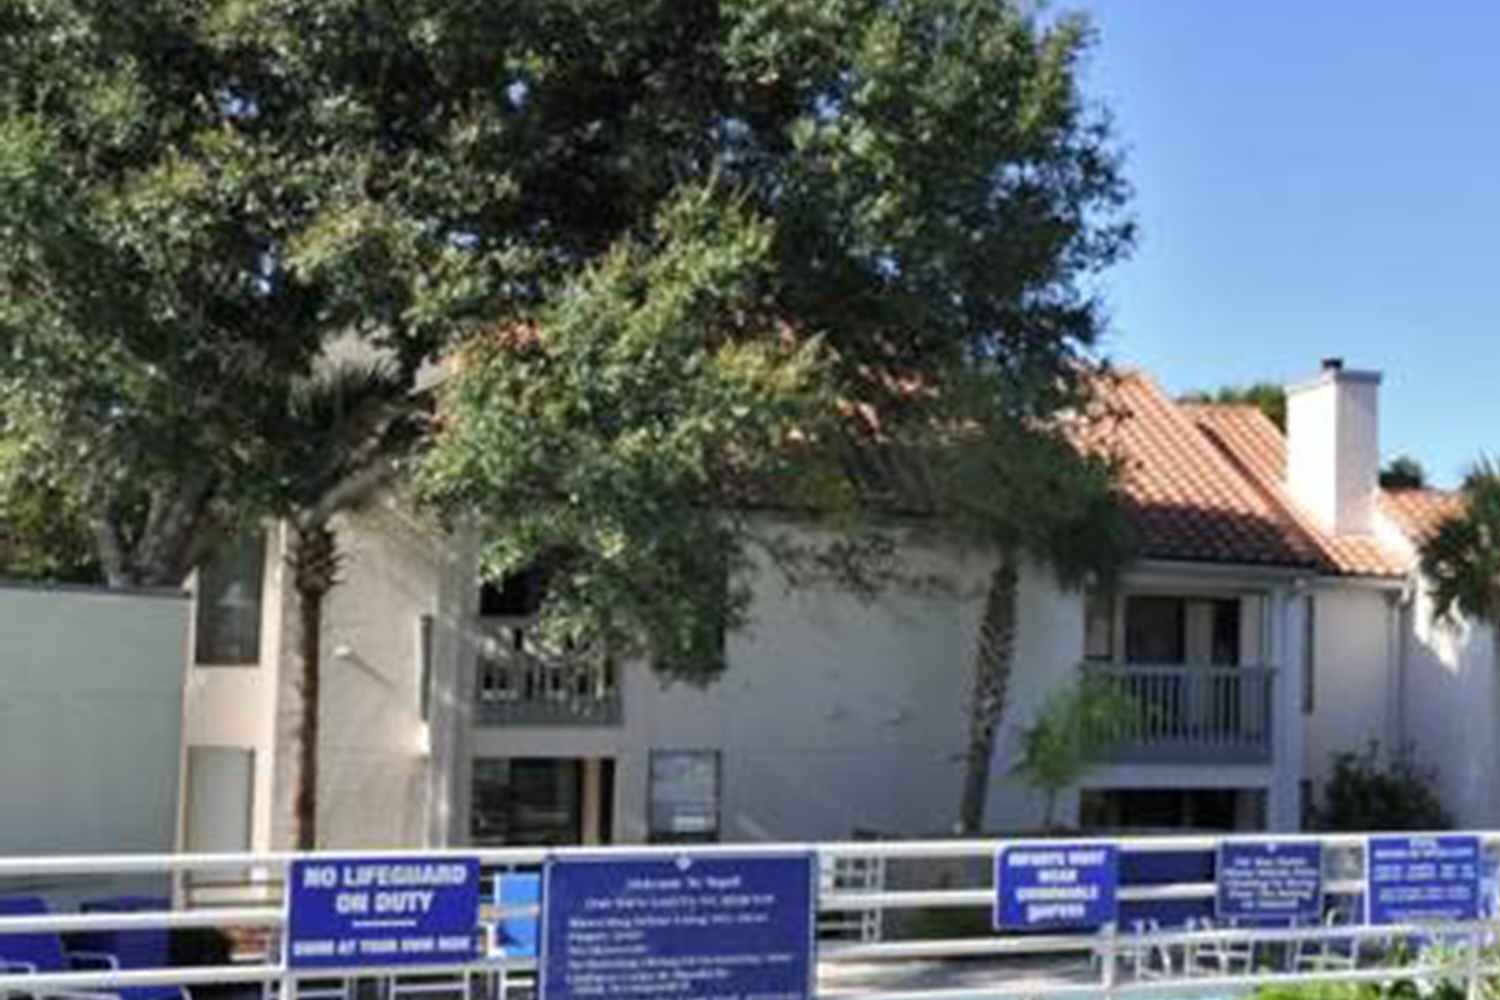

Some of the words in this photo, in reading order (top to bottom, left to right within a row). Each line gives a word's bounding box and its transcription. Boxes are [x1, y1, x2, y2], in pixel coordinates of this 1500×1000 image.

[303, 866, 337, 888] NO
[342, 864, 468, 886] LIFEGUARD
[335, 891, 369, 914] ON
[373, 890, 435, 913] DUTY
